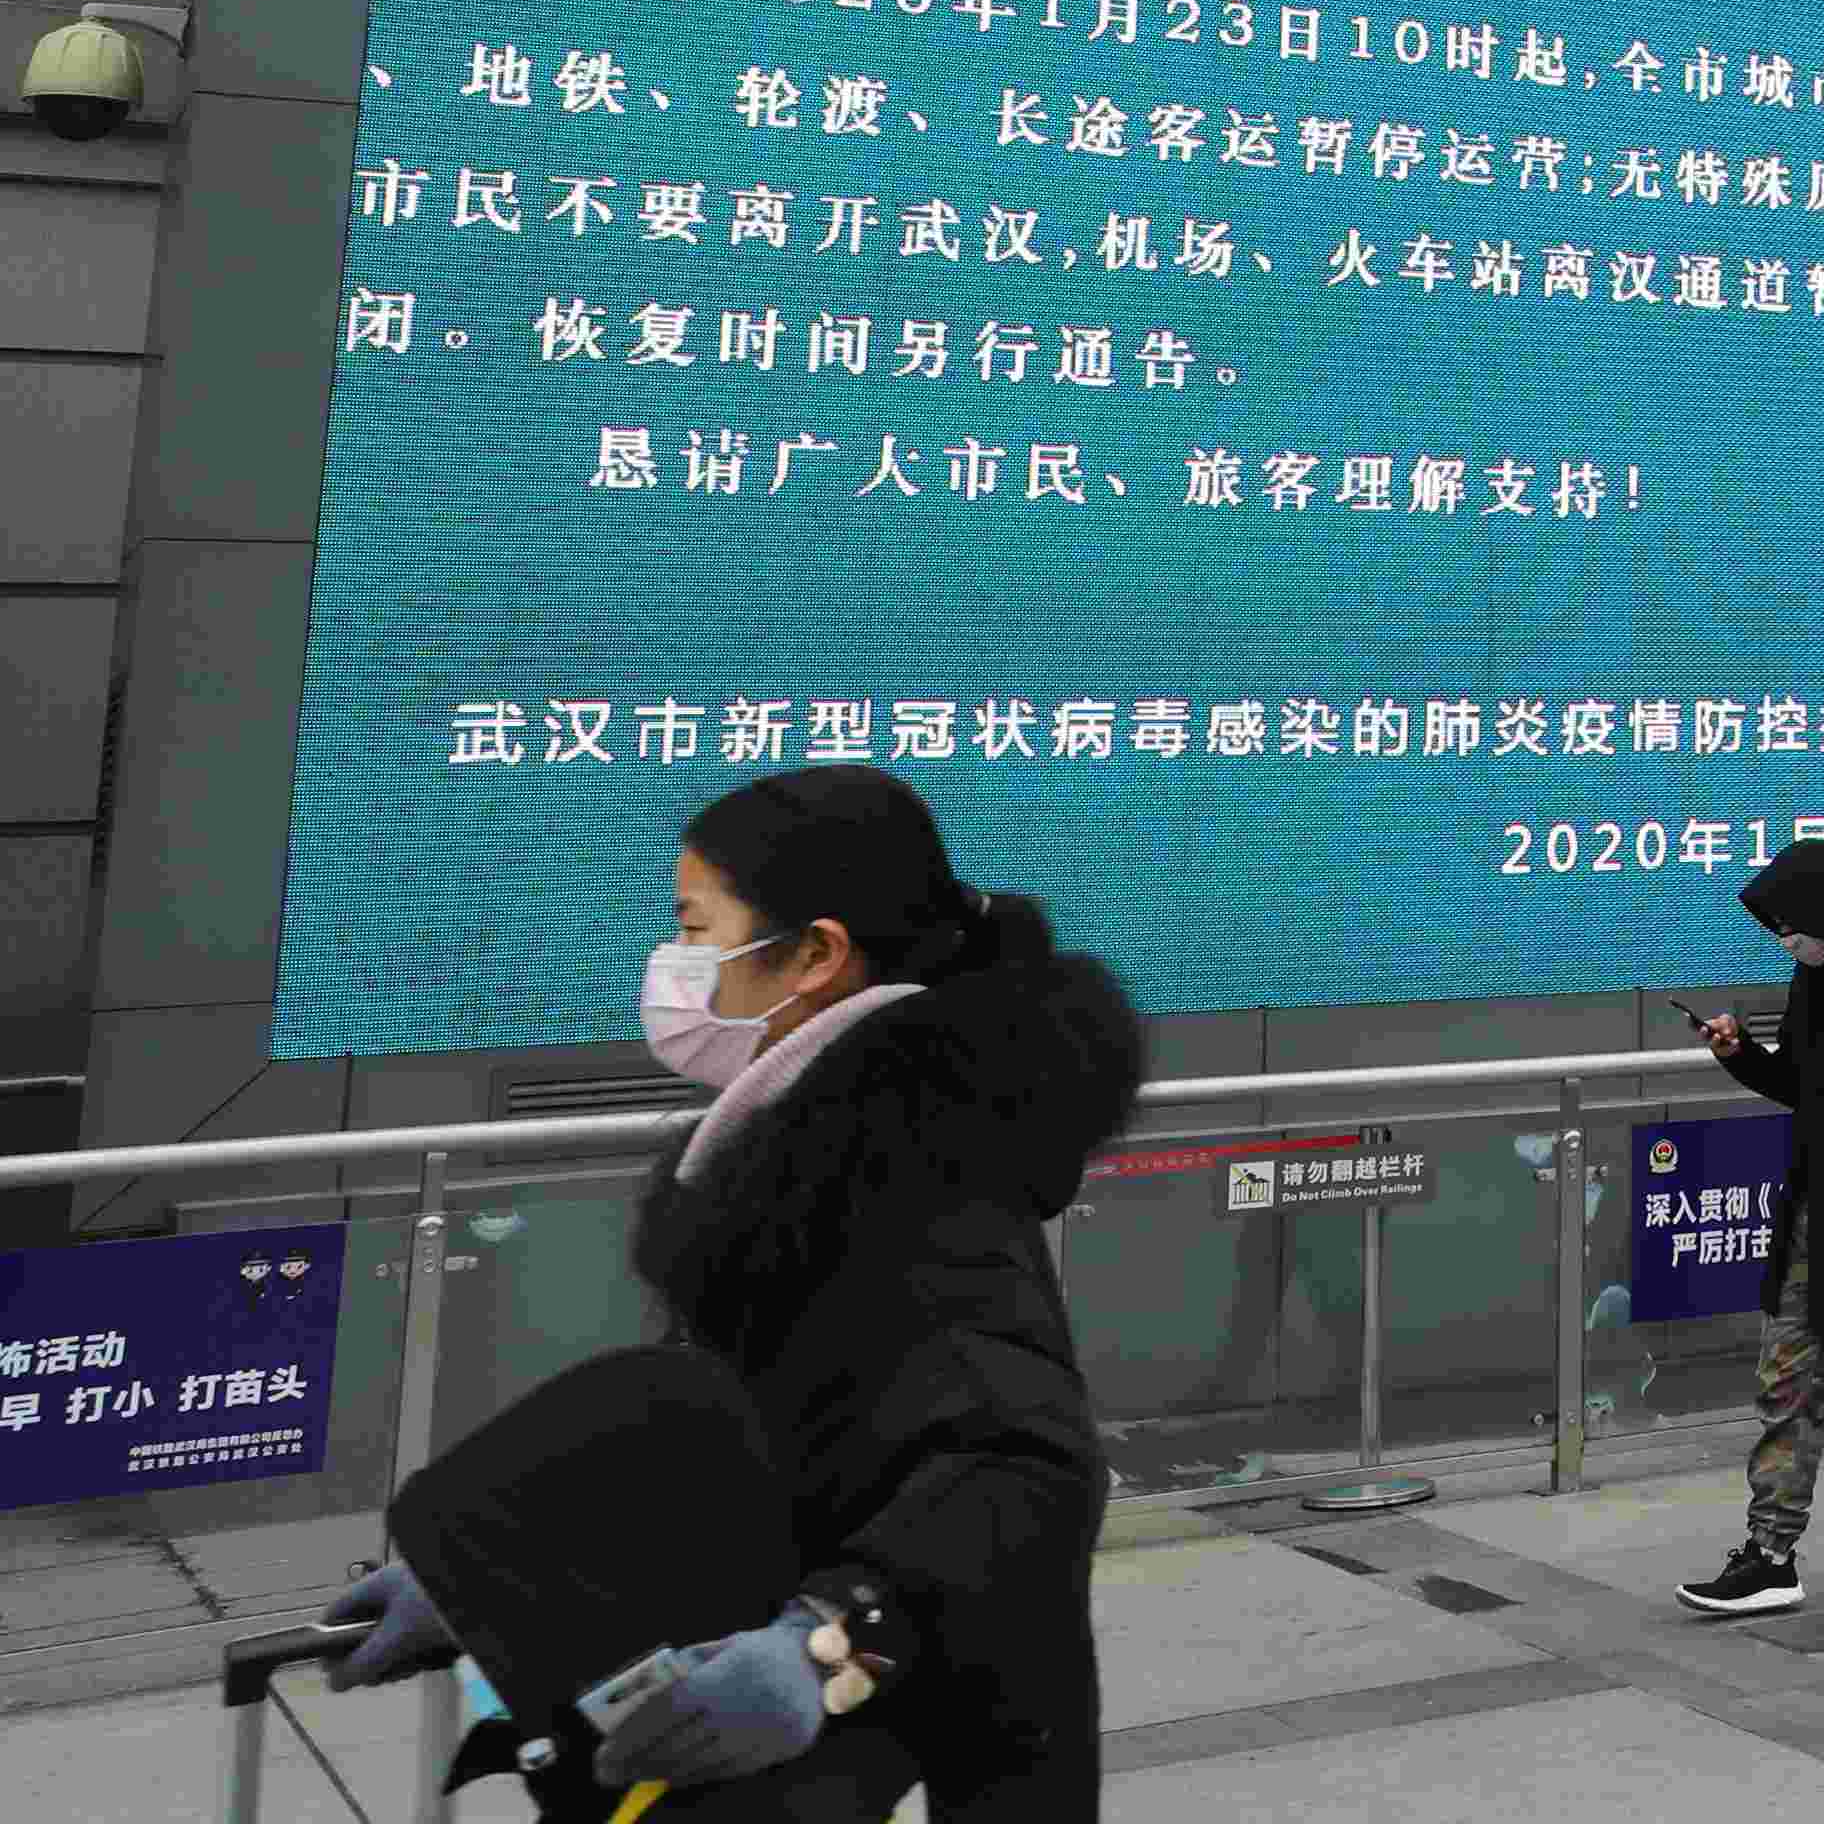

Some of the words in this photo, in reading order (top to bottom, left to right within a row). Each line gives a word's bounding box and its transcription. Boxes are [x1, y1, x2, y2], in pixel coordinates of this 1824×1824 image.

[1281, 1153, 1425, 1186] 请勿翻越栏杆
[1282, 1192, 1298, 1202] Do
[1299, 1191, 1319, 1201] Not
[1646, 1182, 1783, 1228] 深入贯彻《
[1671, 1225, 1773, 1268] 严厉打击
[65, 1379, 156, 1426] 打小
[177, 1365, 308, 1414] 打苗头
